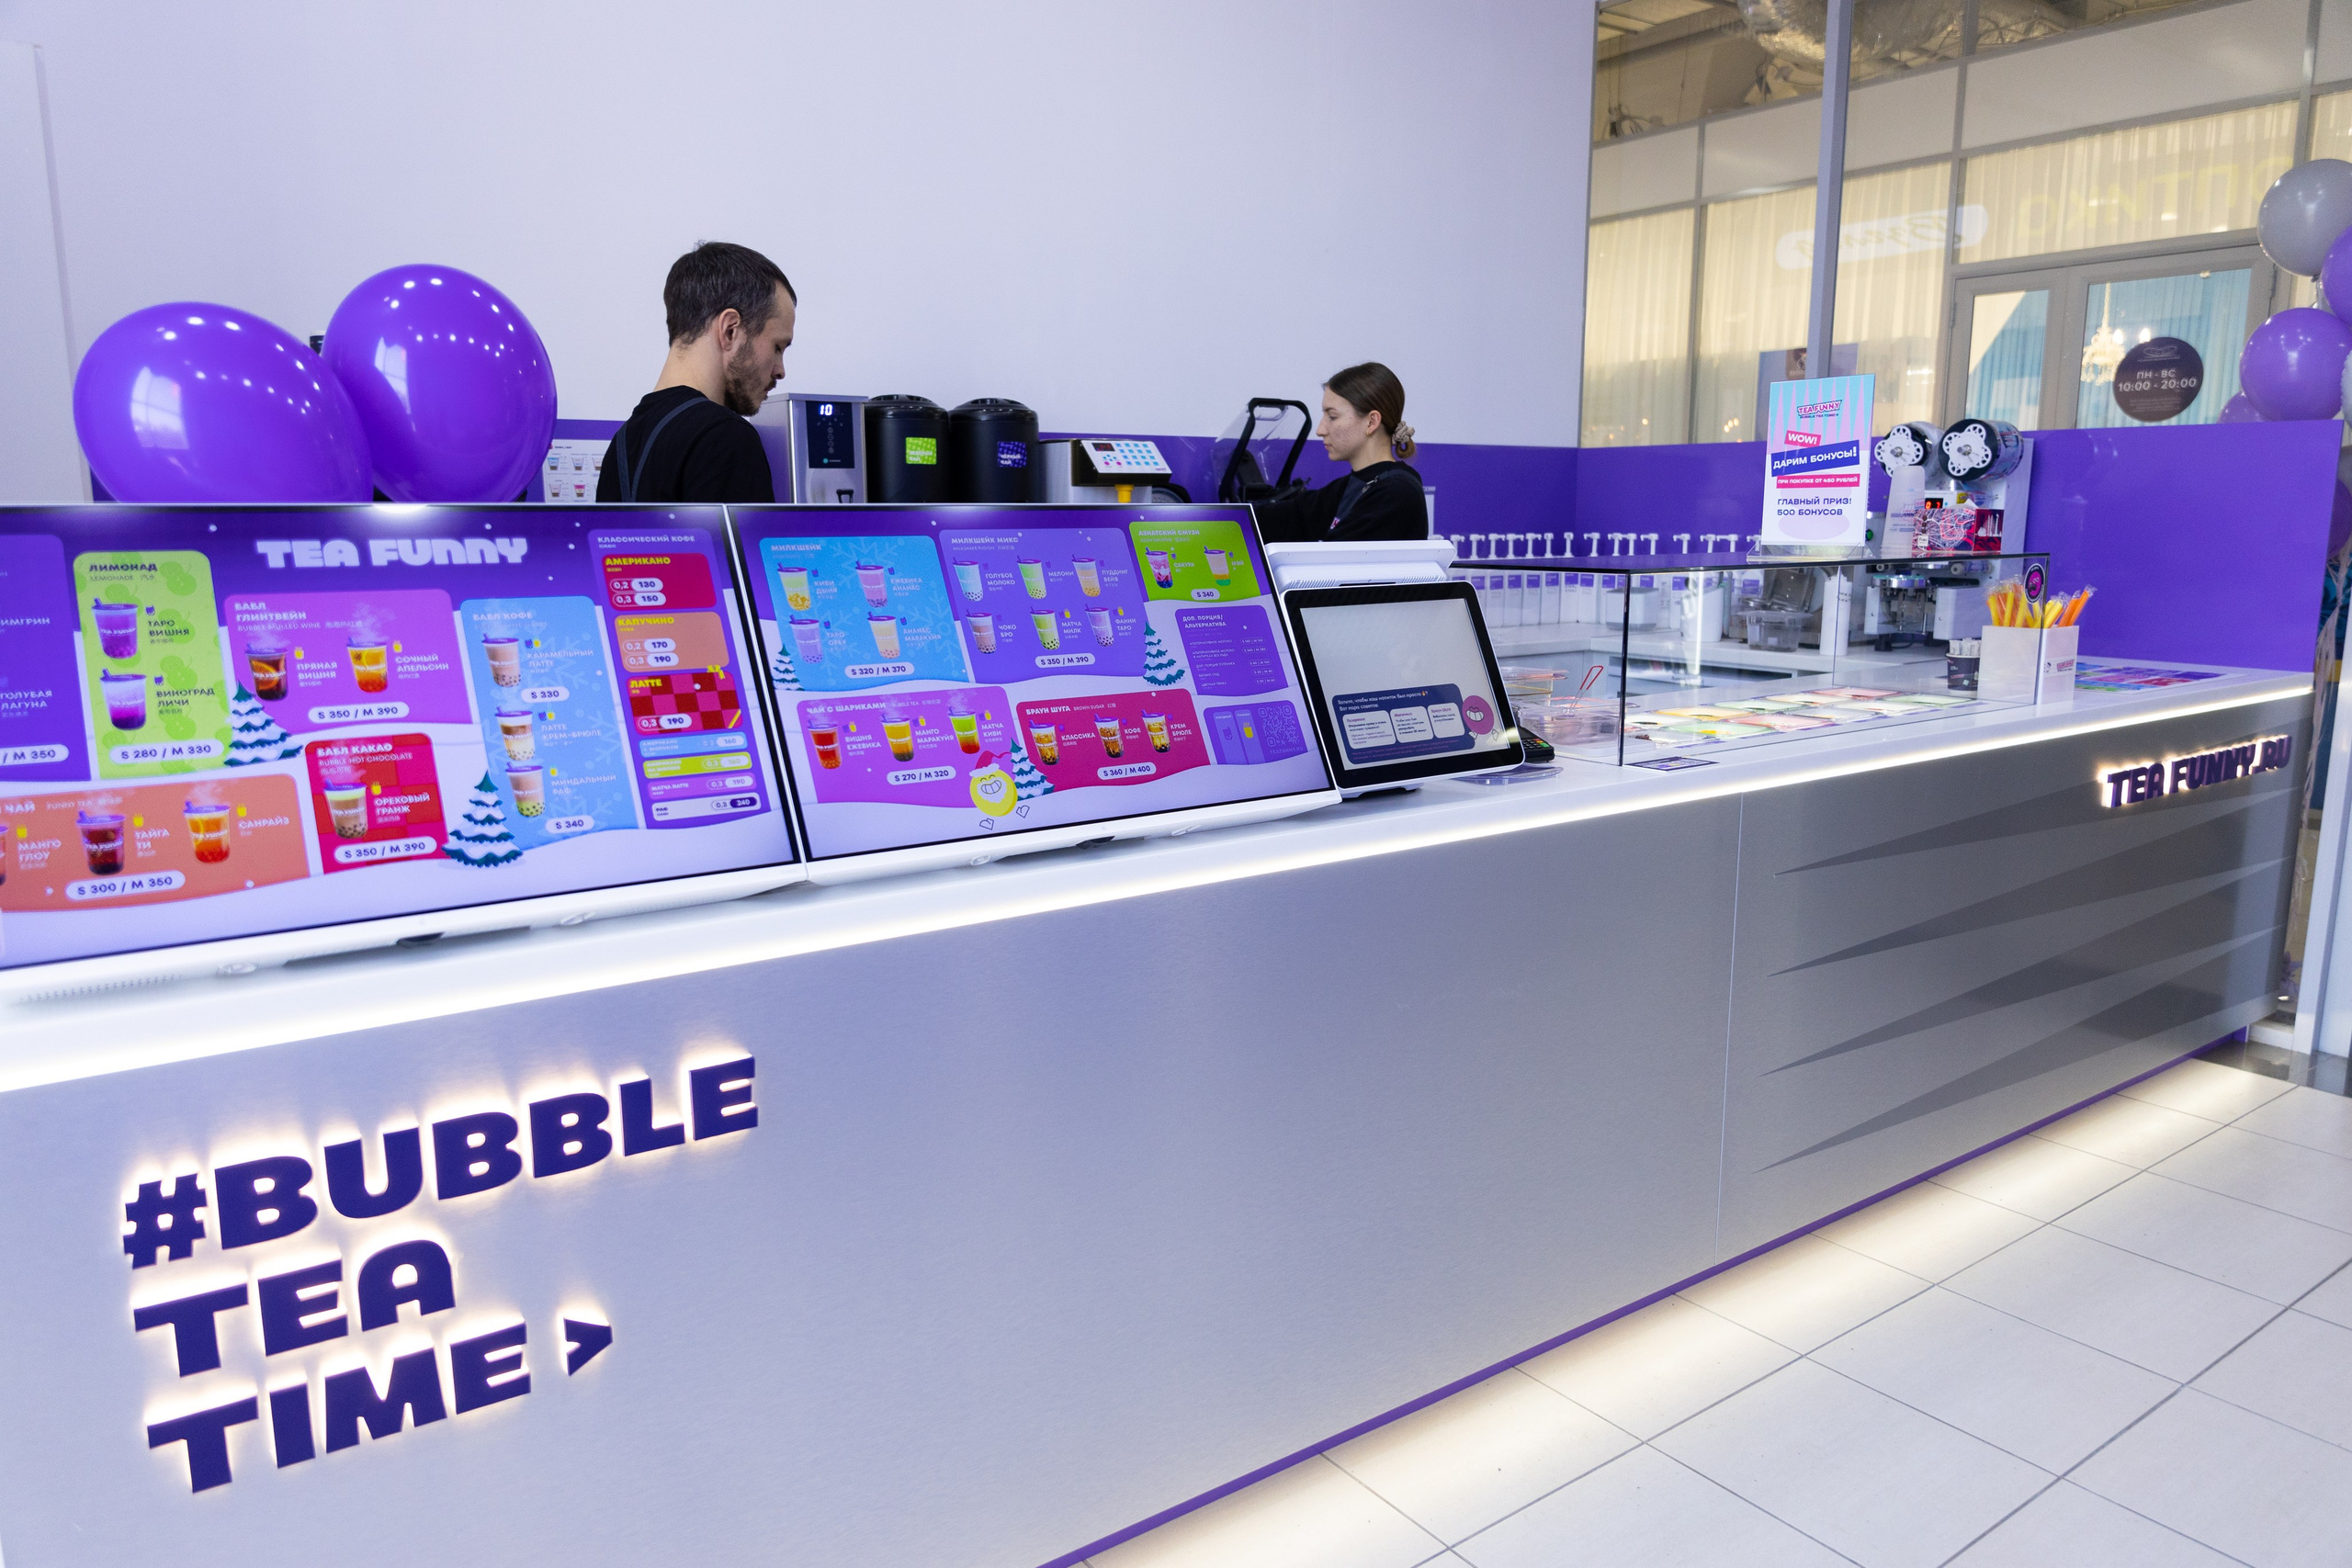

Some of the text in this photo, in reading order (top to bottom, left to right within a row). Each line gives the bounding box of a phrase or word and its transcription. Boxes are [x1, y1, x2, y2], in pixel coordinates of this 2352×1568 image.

[2161, 369, 2176, 378] ВС
[2118, 378, 2196, 391] 10:00 20:00
[820, 404, 832, 415] 10
[1814, 401, 1841, 412] FUNNY
[1788, 434, 1817, 445] WOW!
[1773, 446, 1857, 468] ДАРИМ БОНУСЫ!
[1777, 496, 1819, 505] ГЛАВНЫЙ
[597, 535, 669, 543] КЛАССИЧЕСКИЙ
[771, 543, 821, 551] МИЛКШЕЙК
[256, 538, 527, 569] TEA FUNNY
[605, 557, 671, 566] АМЕРИКАНО
[89, 563, 158, 572] ЛИМОНАД
[616, 595, 632, 604] 0,3
[237, 610, 307, 622] ГЛИНТВЕЙН
[617, 617, 674, 626] КАПУЧИНО
[149, 627, 189, 637] ВИШНЯ
[395, 654, 439, 664] СОЧНЫЙ
[527, 649, 594, 659] КАРАМЕЛЬНЫЙ
[297, 661, 338, 671] ПРЯНАЯ
[397, 663, 449, 672] АПЕЛЬСИН
[299, 671, 336, 680] ВИШНЯ
[630, 679, 662, 688] ЛАТТЕ
[0, 691, 52, 700] ГОЛУБАЯ
[156, 688, 215, 698] ВИНОГРАД
[2, 700, 48, 709] ЛАГУНА
[158, 699, 189, 707] ЛИЧИ
[329, 710, 350, 718] 350
[363, 708, 373, 716] M
[377, 706, 399, 715] 390
[807, 705, 825, 715] ЧАЙ
[836, 702, 886, 712] ШАРИКАМИ
[1025, 707, 1049, 716] БРАУН
[543, 729, 602, 740] КРЕМ-БРЮЛЕ
[917, 735, 954, 744] МАРАКУЙЯ
[1061, 733, 1095, 741] КЛАССИКА
[317, 743, 393, 757] БАБЛ КАКАО
[847, 742, 882, 750] ЕЖЕВИКА
[13, 750, 56, 761] M 350
[121, 745, 211, 760] S 280 M 330
[367, 753, 413, 762] CHOCOLATE
[551, 775, 617, 786] МИНДАЛЬНЫЙ
[2108, 763, 2165, 808] TEA
[375, 792, 430, 807] ОРЕХОВЫЙ
[6, 801, 35, 814] ЧАЙ
[377, 805, 410, 816] ГРАНЖ
[239, 816, 290, 829] САНРАЙЗ
[566, 819, 584, 829] 340
[135, 828, 170, 840] ТАЙГА
[17, 840, 62, 851] МАНГО
[356, 848, 377, 856] 350
[390, 845, 401, 853] M
[404, 842, 425, 851] 390
[18, 852, 50, 862] ГЛОУ
[77, 876, 173, 896] S 300 M 350
[122, 1056, 758, 1269] #BUBBLE
[133, 1240, 456, 1377] TEA
[146, 1322, 531, 1493] TIME
